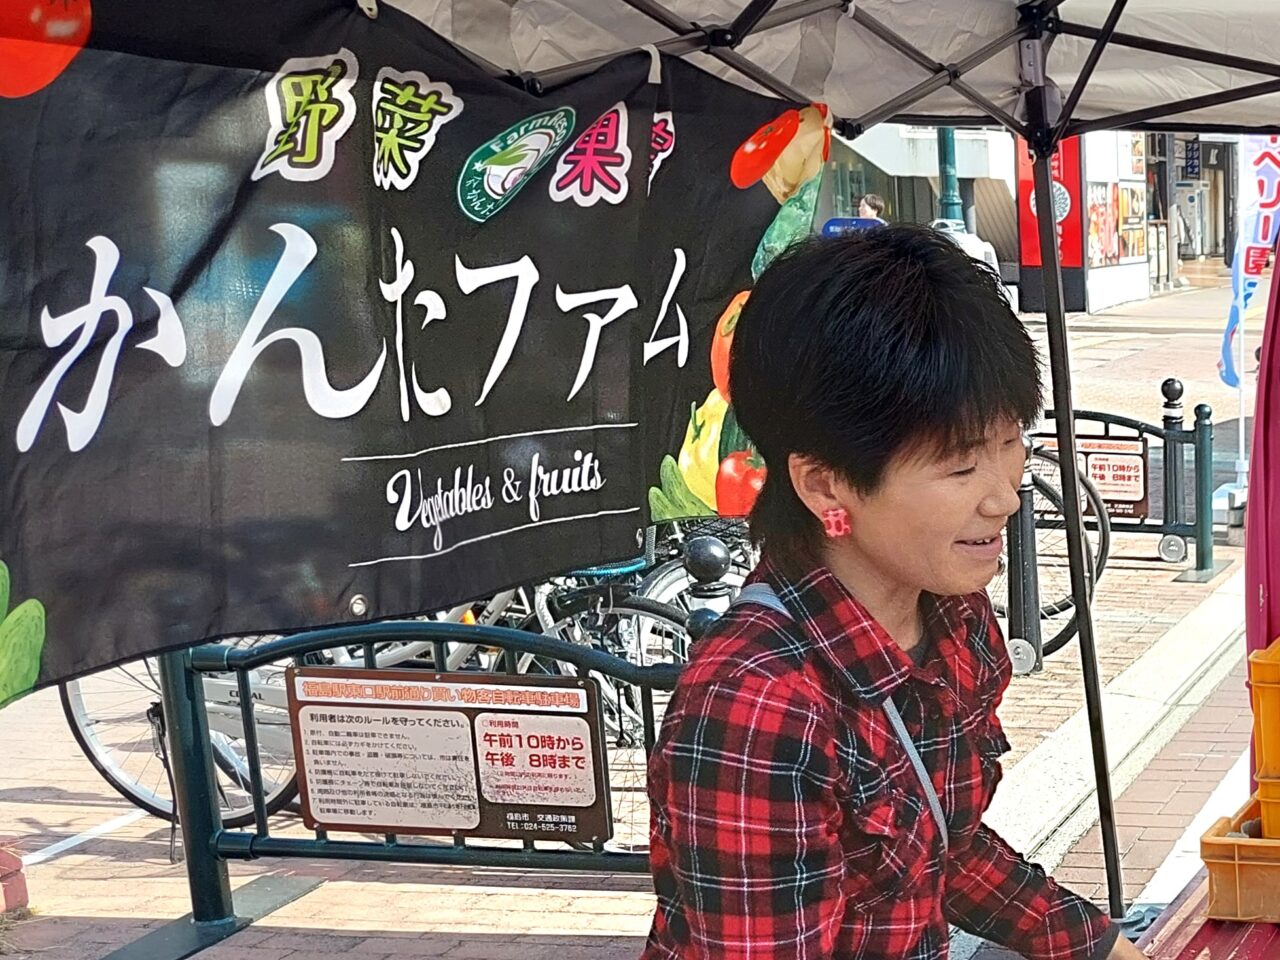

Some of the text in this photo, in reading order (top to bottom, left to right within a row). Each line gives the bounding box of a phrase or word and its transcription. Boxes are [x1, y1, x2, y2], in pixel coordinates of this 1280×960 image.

[258, 58, 456, 180] 野菜
[386, 450, 606, 551] Vegetables & fruits
[483, 732, 584, 751] 午前10時から
[485, 751, 516, 768] 午後
[528, 753, 586, 770] 8時まで
